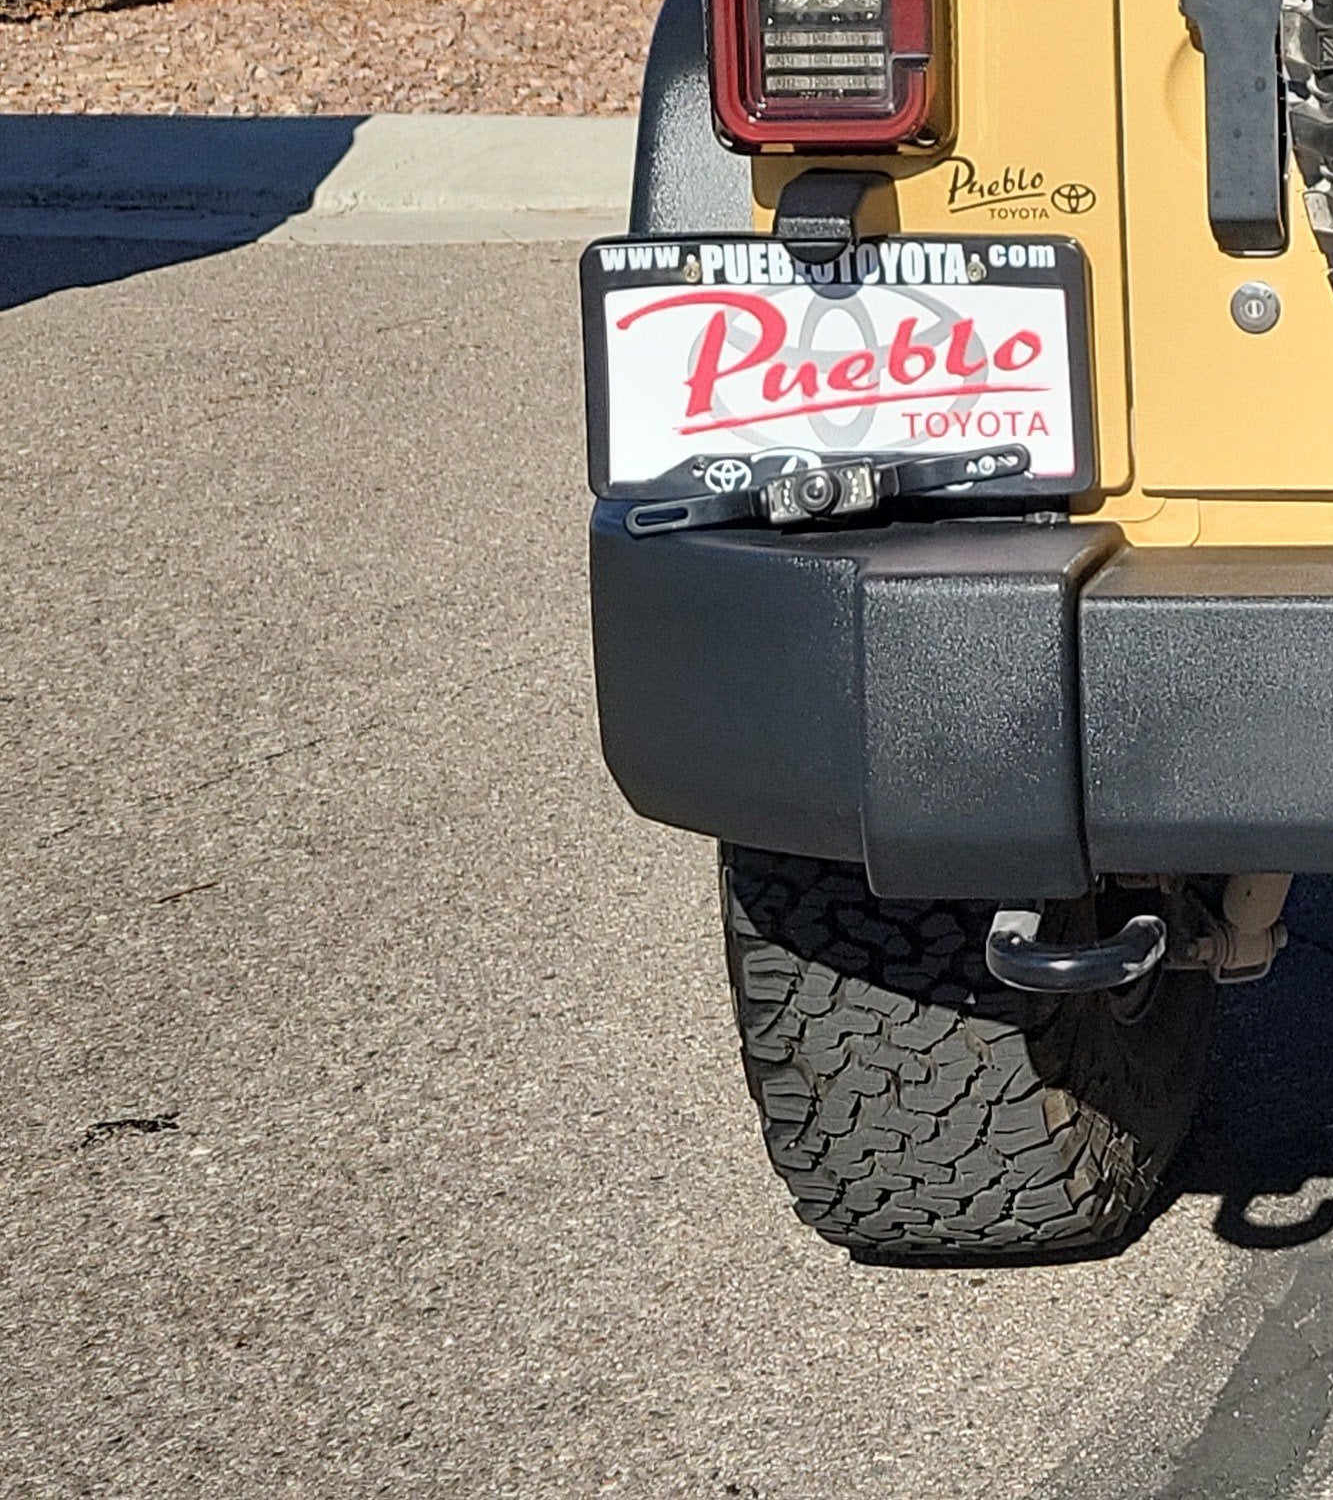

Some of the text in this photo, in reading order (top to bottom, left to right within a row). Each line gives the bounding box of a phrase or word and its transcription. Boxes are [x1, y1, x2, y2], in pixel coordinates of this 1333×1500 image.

[947, 156, 1045, 207] Pueblo
[989, 207, 1049, 219] TOYOTA
[617, 291, 1043, 421] Pueblo
[903, 411, 1049, 439] TOYOTA
